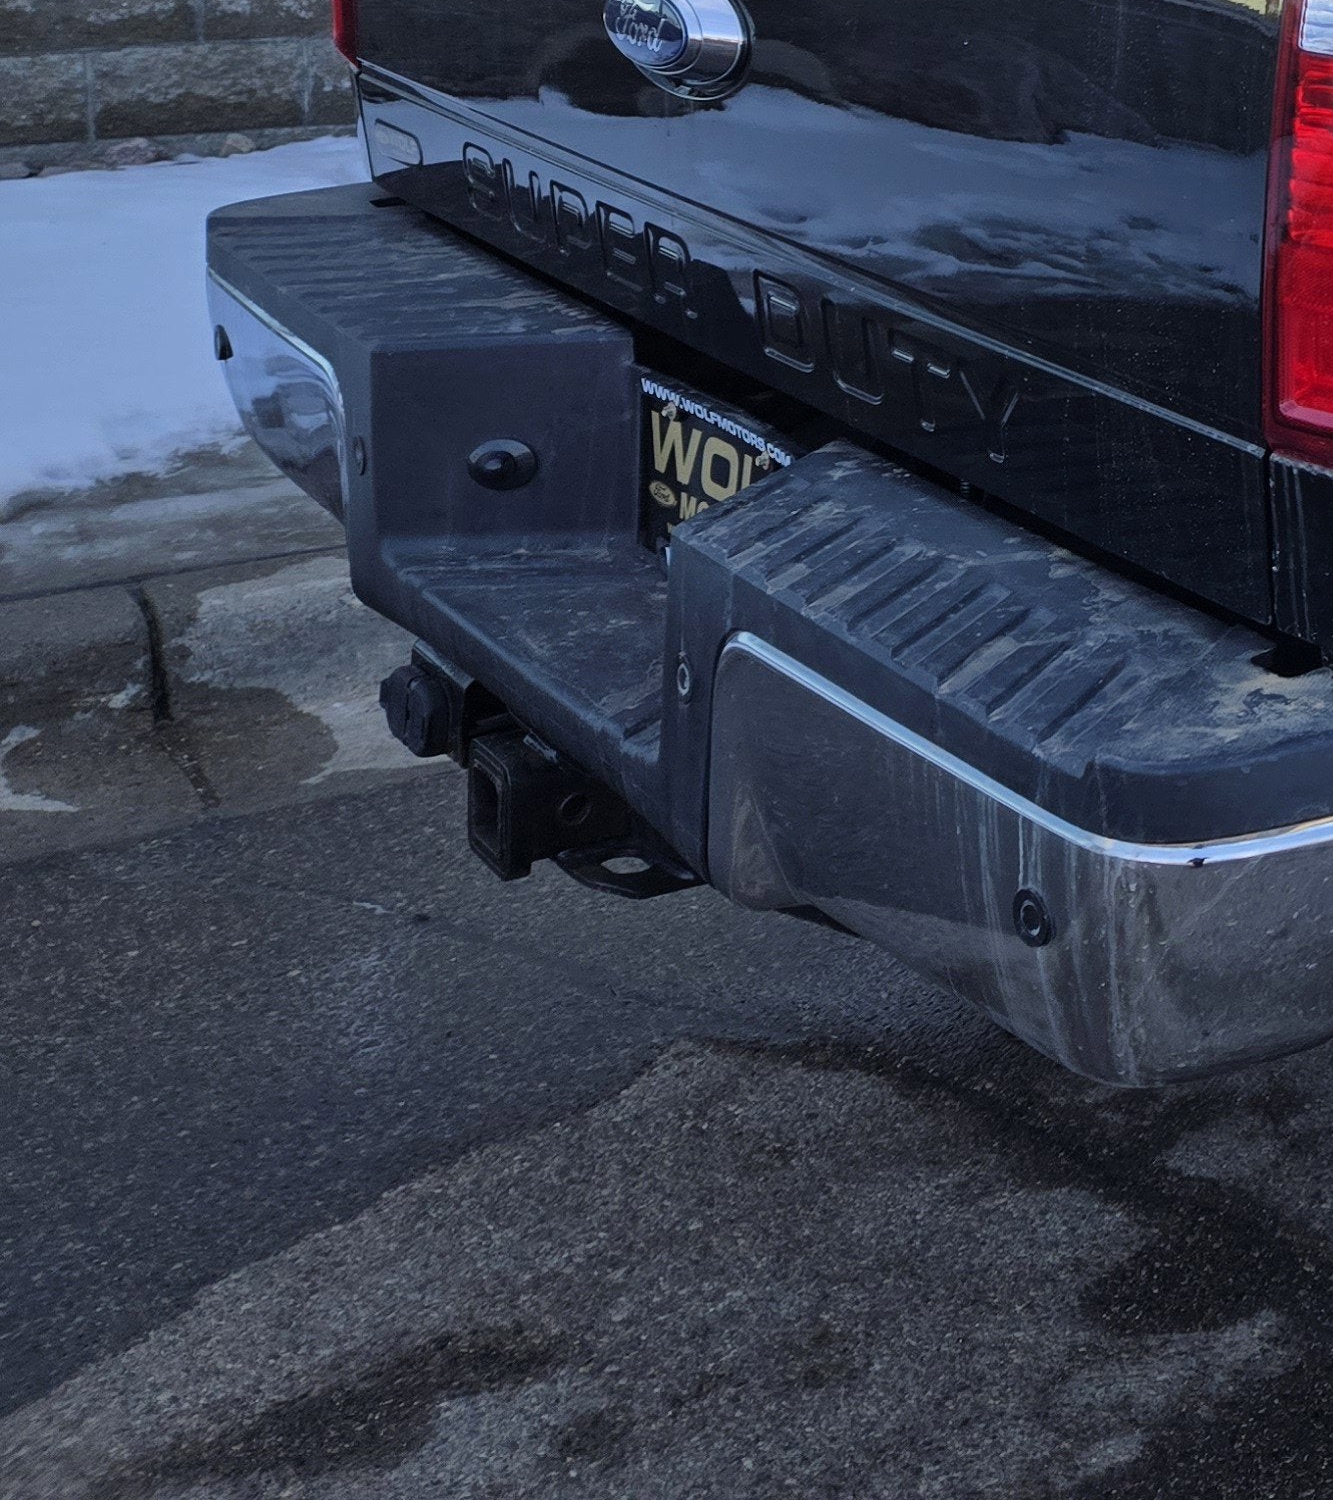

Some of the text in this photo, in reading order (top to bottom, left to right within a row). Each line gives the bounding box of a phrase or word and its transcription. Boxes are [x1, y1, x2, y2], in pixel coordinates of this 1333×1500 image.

[462, 141, 699, 320] SUPER
[641, 377, 792, 468] WWW.WOLFMOTORSCOM
[752, 269, 1022, 464] DUTY
